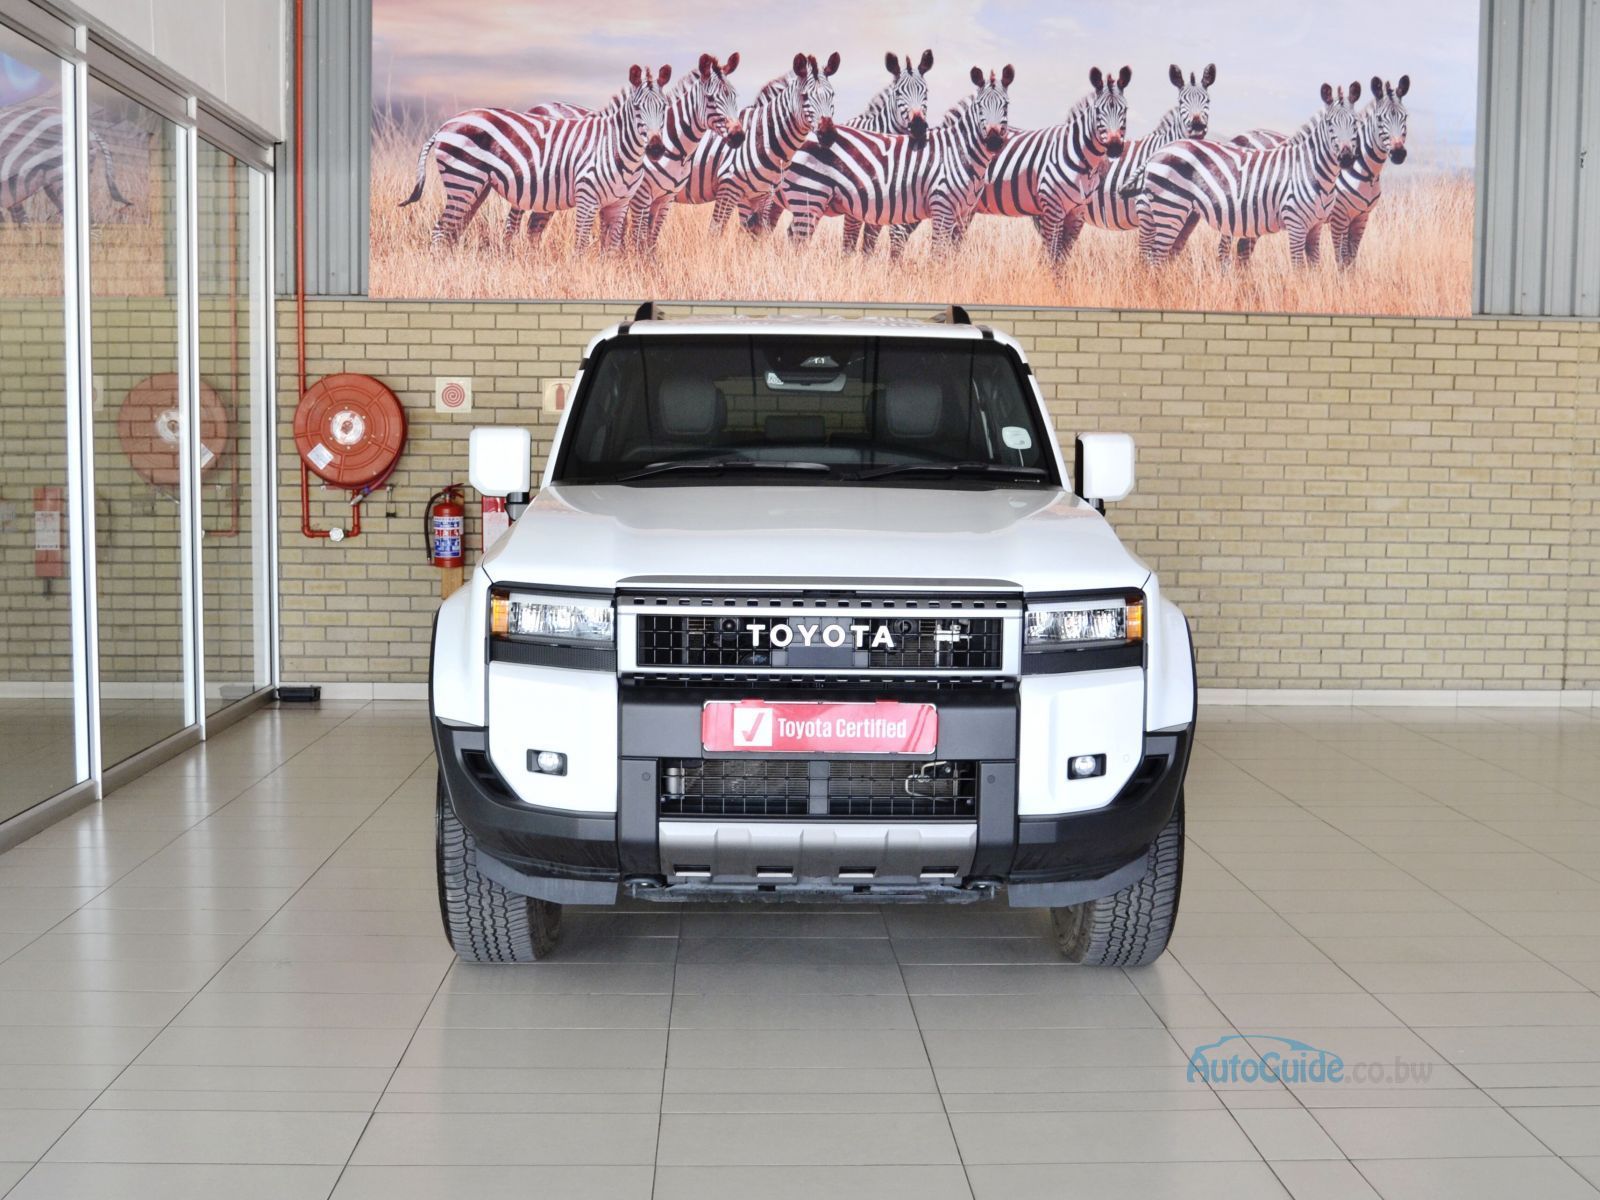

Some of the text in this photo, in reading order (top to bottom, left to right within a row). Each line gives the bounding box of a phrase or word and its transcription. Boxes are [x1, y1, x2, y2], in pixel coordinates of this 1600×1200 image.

[746, 624, 895, 648] TOYOTA
[777, 717, 907, 740] Toyota Certified
